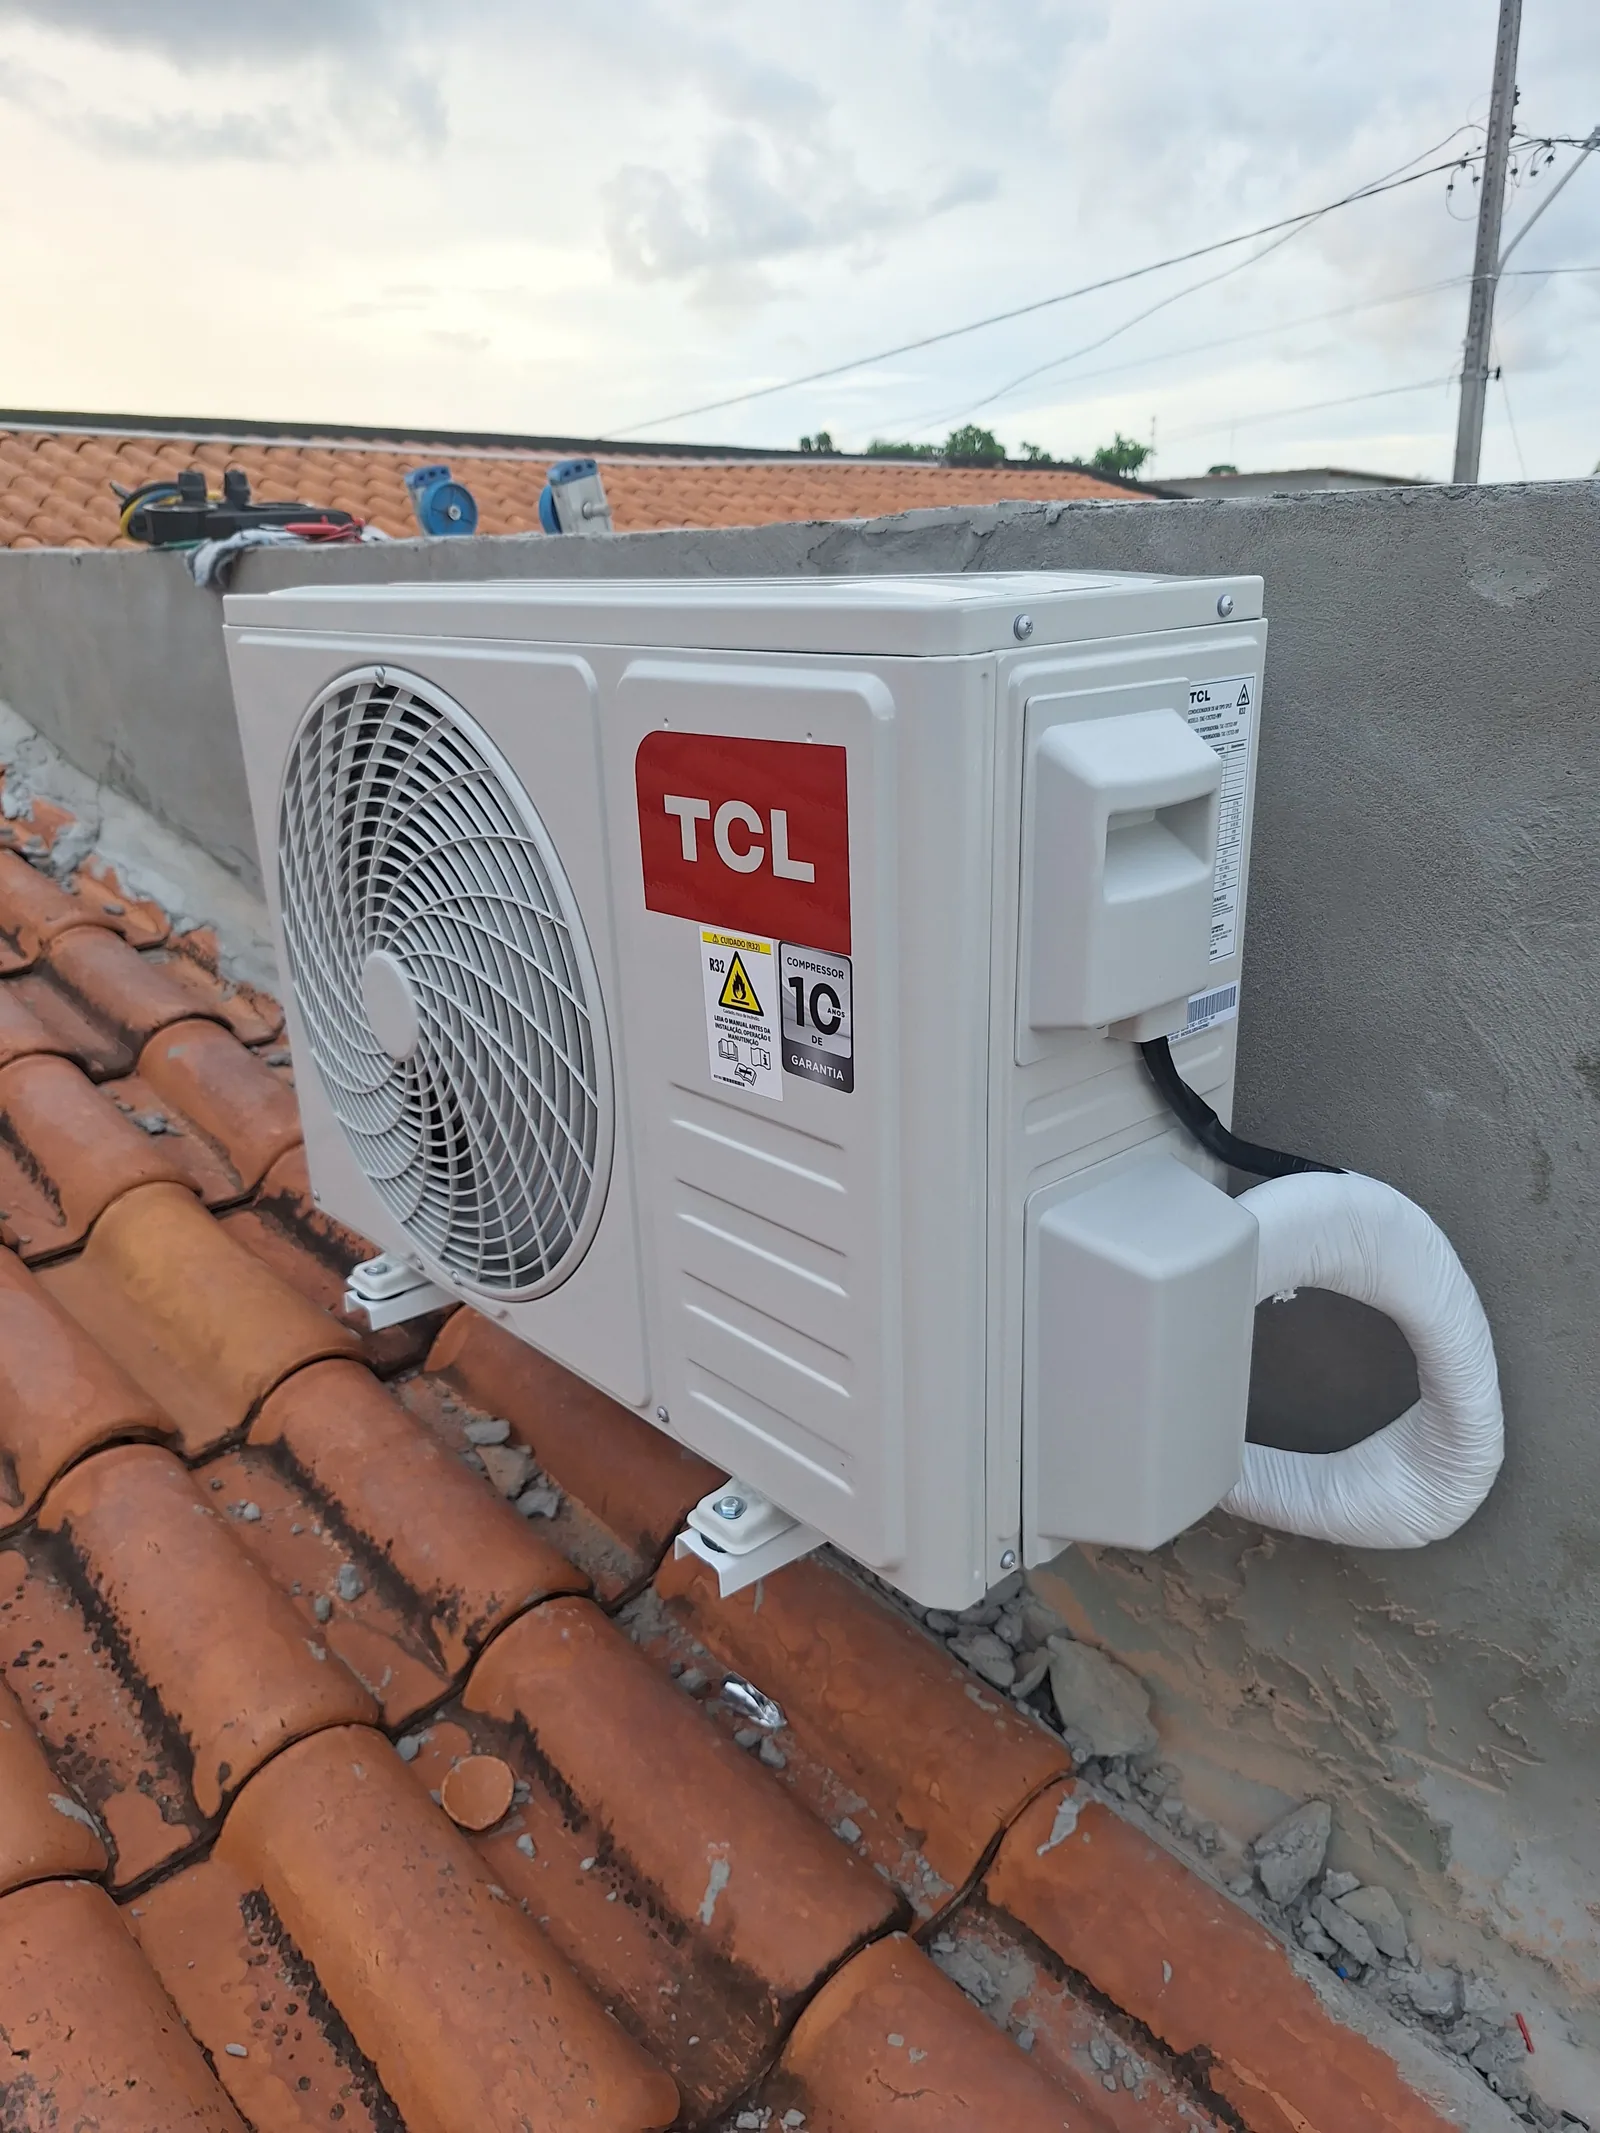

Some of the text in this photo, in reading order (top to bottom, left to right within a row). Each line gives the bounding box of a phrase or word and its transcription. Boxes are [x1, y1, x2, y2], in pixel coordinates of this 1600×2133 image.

[1189, 690, 1211, 704] TCL
[663, 794, 815, 884] TCL
[720, 936, 761, 952] CUIDADO (R32)
[709, 957, 725, 973] R32
[786, 956, 845, 980] COMPRESSOR
[788, 976, 846, 1036] 10 ANOS
[714, 1015, 724, 1023] LEIA
[729, 1018, 749, 1029] MANUAL
[749, 1023, 763, 1033] ANTES
[715, 1022, 743, 1034] INSTALAÇÃO,
[743, 1029, 767, 1042] OPERAÇÃO
[728, 1033, 760, 1046] MANUTENÇÃO
[811, 1035, 823, 1046] DE
[791, 1055, 845, 1081] GARANTIA
